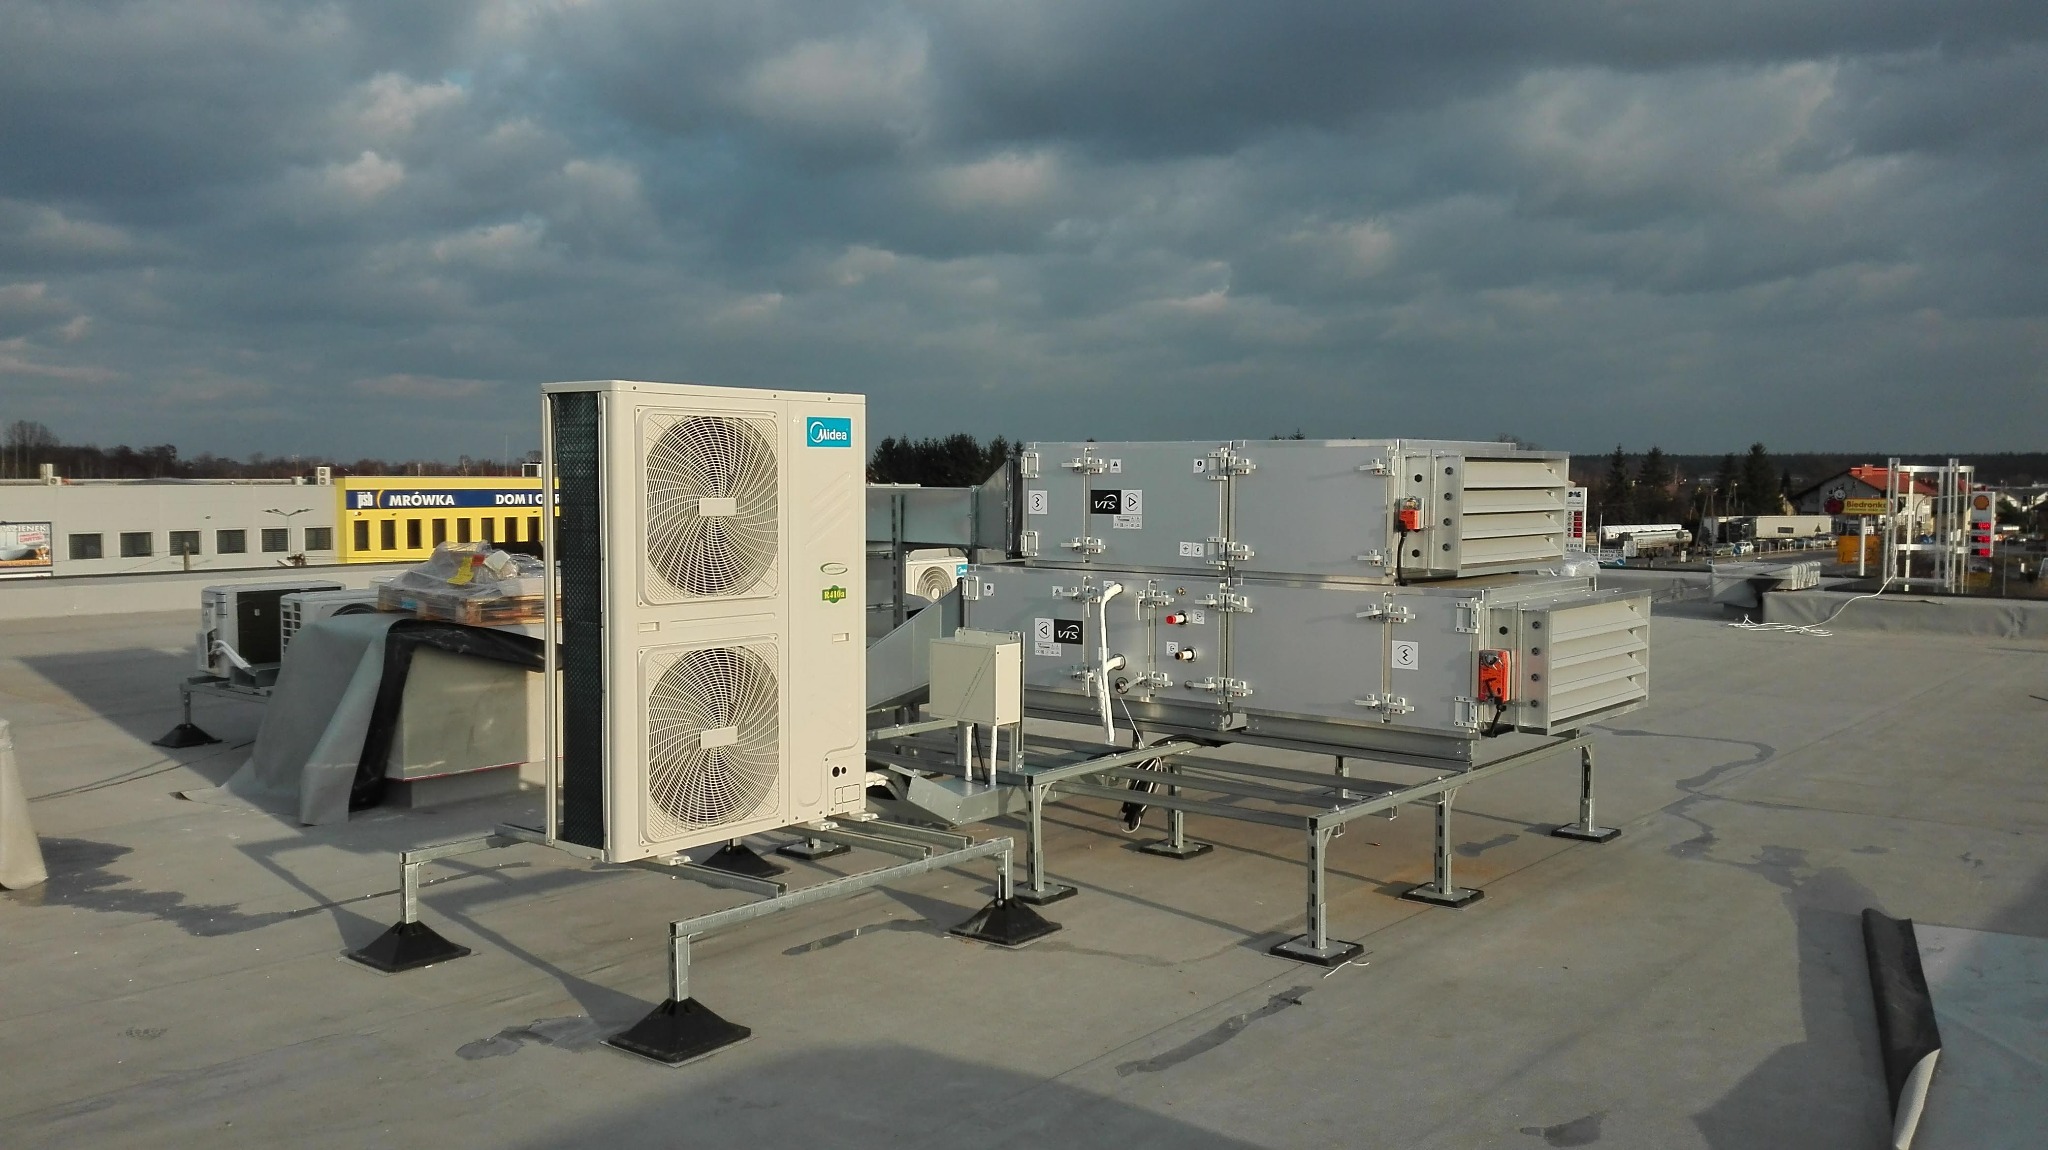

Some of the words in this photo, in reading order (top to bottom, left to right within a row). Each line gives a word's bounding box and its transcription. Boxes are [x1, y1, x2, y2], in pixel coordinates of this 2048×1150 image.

[813, 425, 847, 441] Midea
[389, 491, 455, 506] MRÓWKA
[495, 494, 526, 505] DOM
[1095, 498, 1117, 509] VTS
[1058, 628, 1079, 640] VTS
